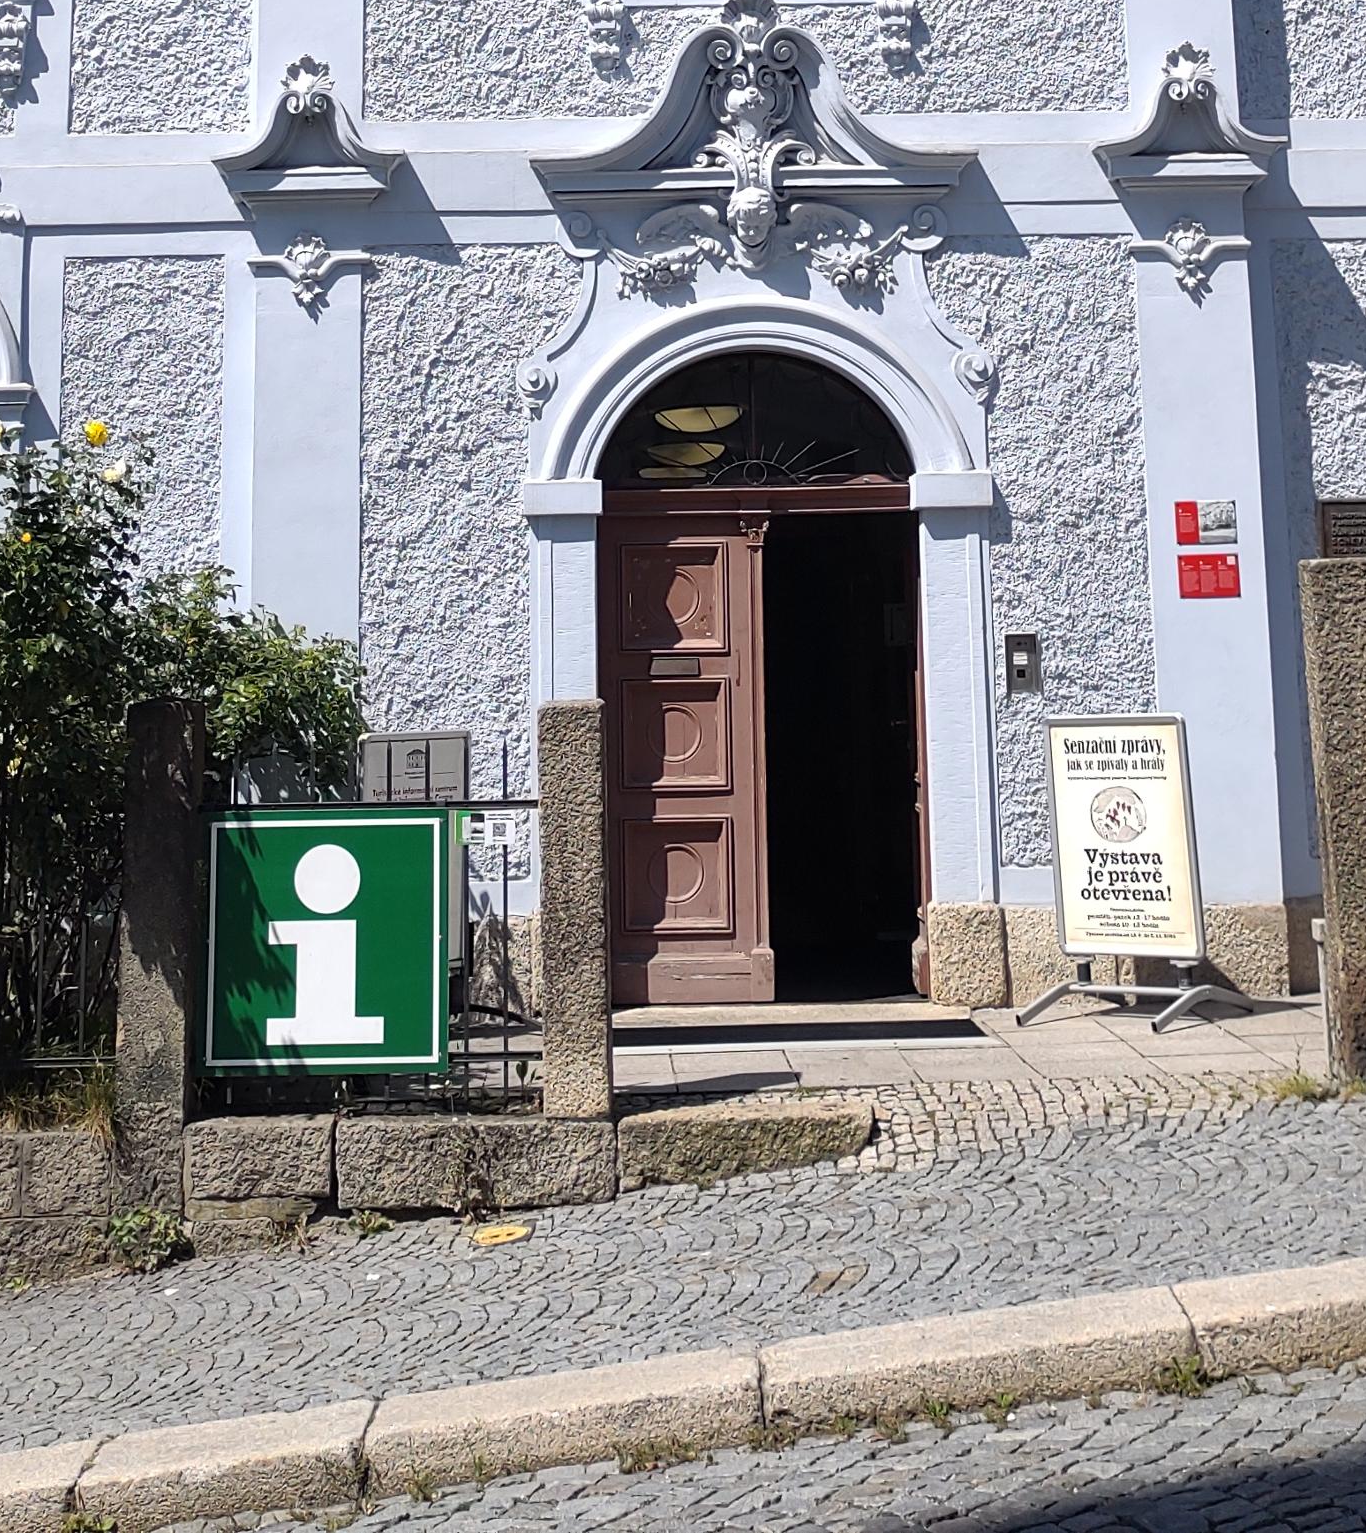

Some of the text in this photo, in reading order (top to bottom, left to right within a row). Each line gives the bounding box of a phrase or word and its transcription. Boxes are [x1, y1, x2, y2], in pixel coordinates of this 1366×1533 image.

[1064, 735, 1166, 756] Senzační zprávy,
[1067, 756, 1165, 772] jak se zpívaly a hrály
[1084, 848, 1163, 868] Výstava
[1087, 866, 1162, 886] je právě
[1081, 885, 1172, 902] otevřena!
